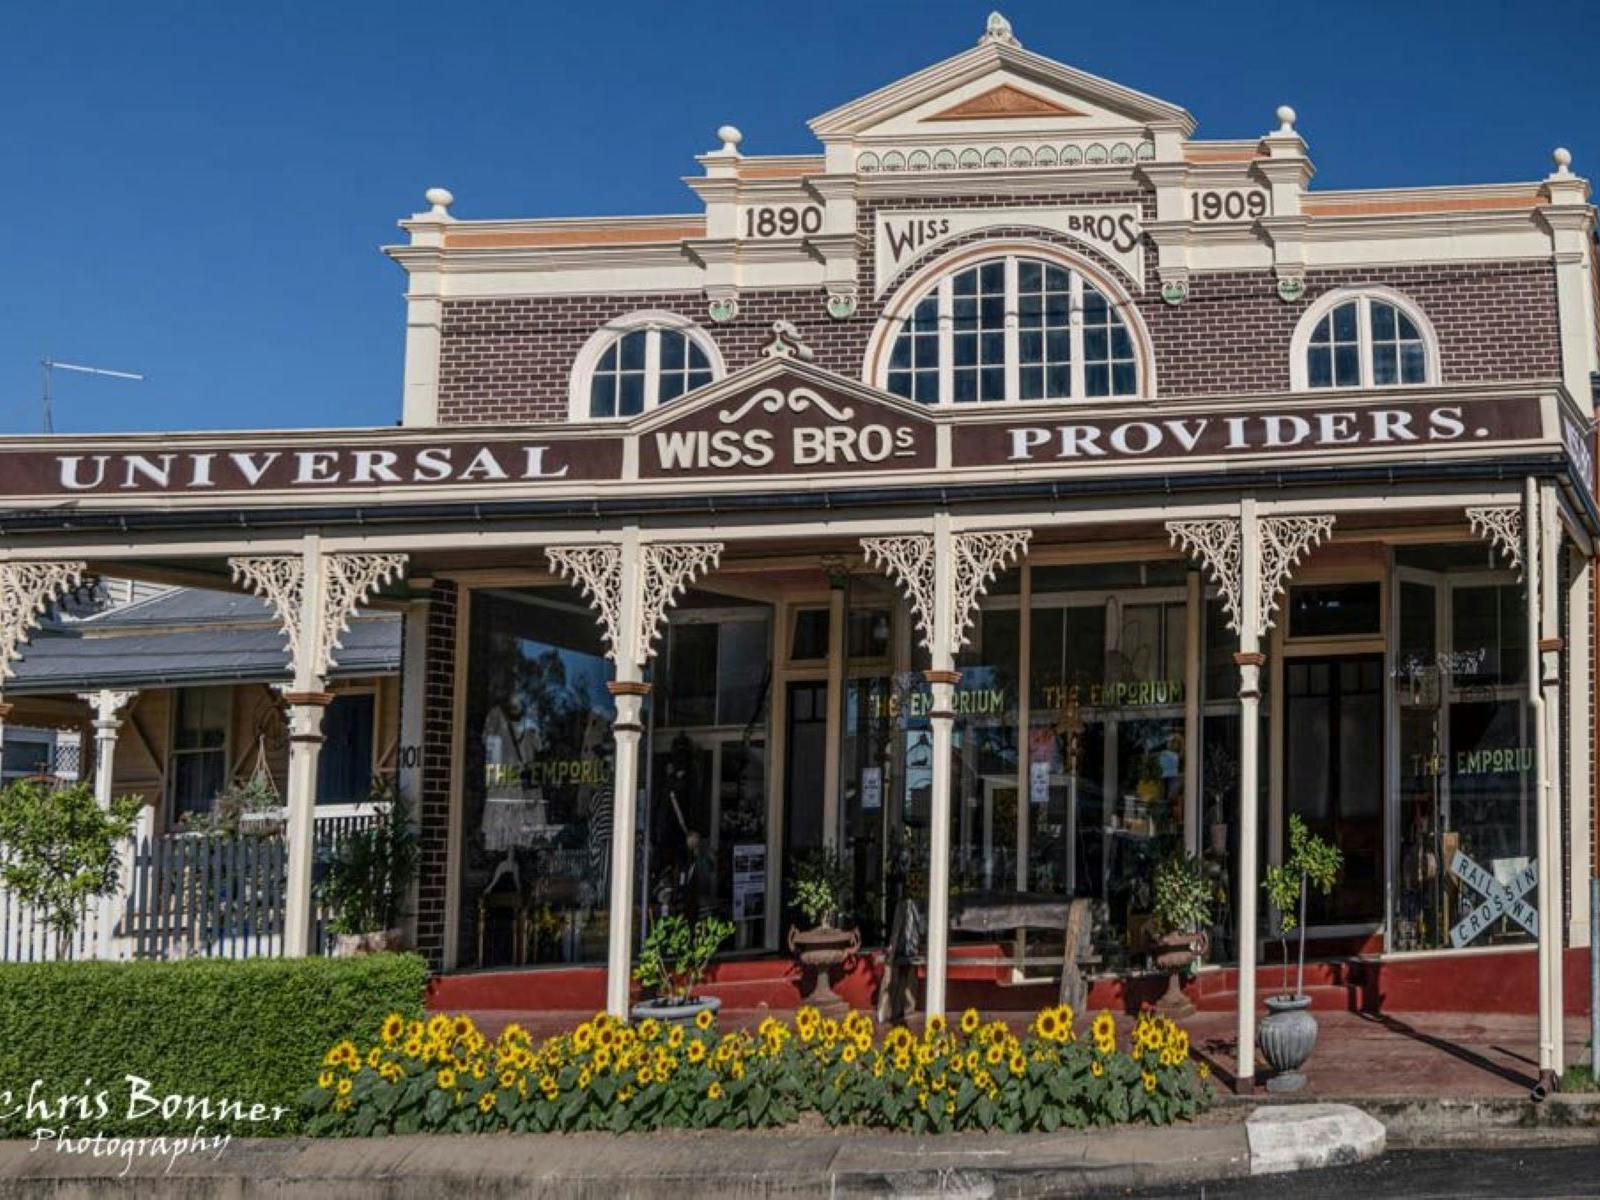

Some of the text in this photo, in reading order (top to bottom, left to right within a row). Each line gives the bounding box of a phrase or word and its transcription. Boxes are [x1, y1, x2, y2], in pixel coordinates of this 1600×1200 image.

[746, 205, 823, 238] 1890
[1190, 189, 1267, 221] 1909
[885, 213, 1142, 264] WISS BROS
[655, 429, 775, 469] WISS
[1007, 406, 1491, 461] PROVIDERS.
[57, 446, 569, 489] UNIVERSAL
[910, 689, 1004, 716] EMORIUM
[1091, 680, 1183, 706] EMPORIUM
[1457, 748, 1536, 773] EMPORIU
[1458, 858, 1535, 929] RAILWA
[1459, 871, 1537, 941] CROSSIN
